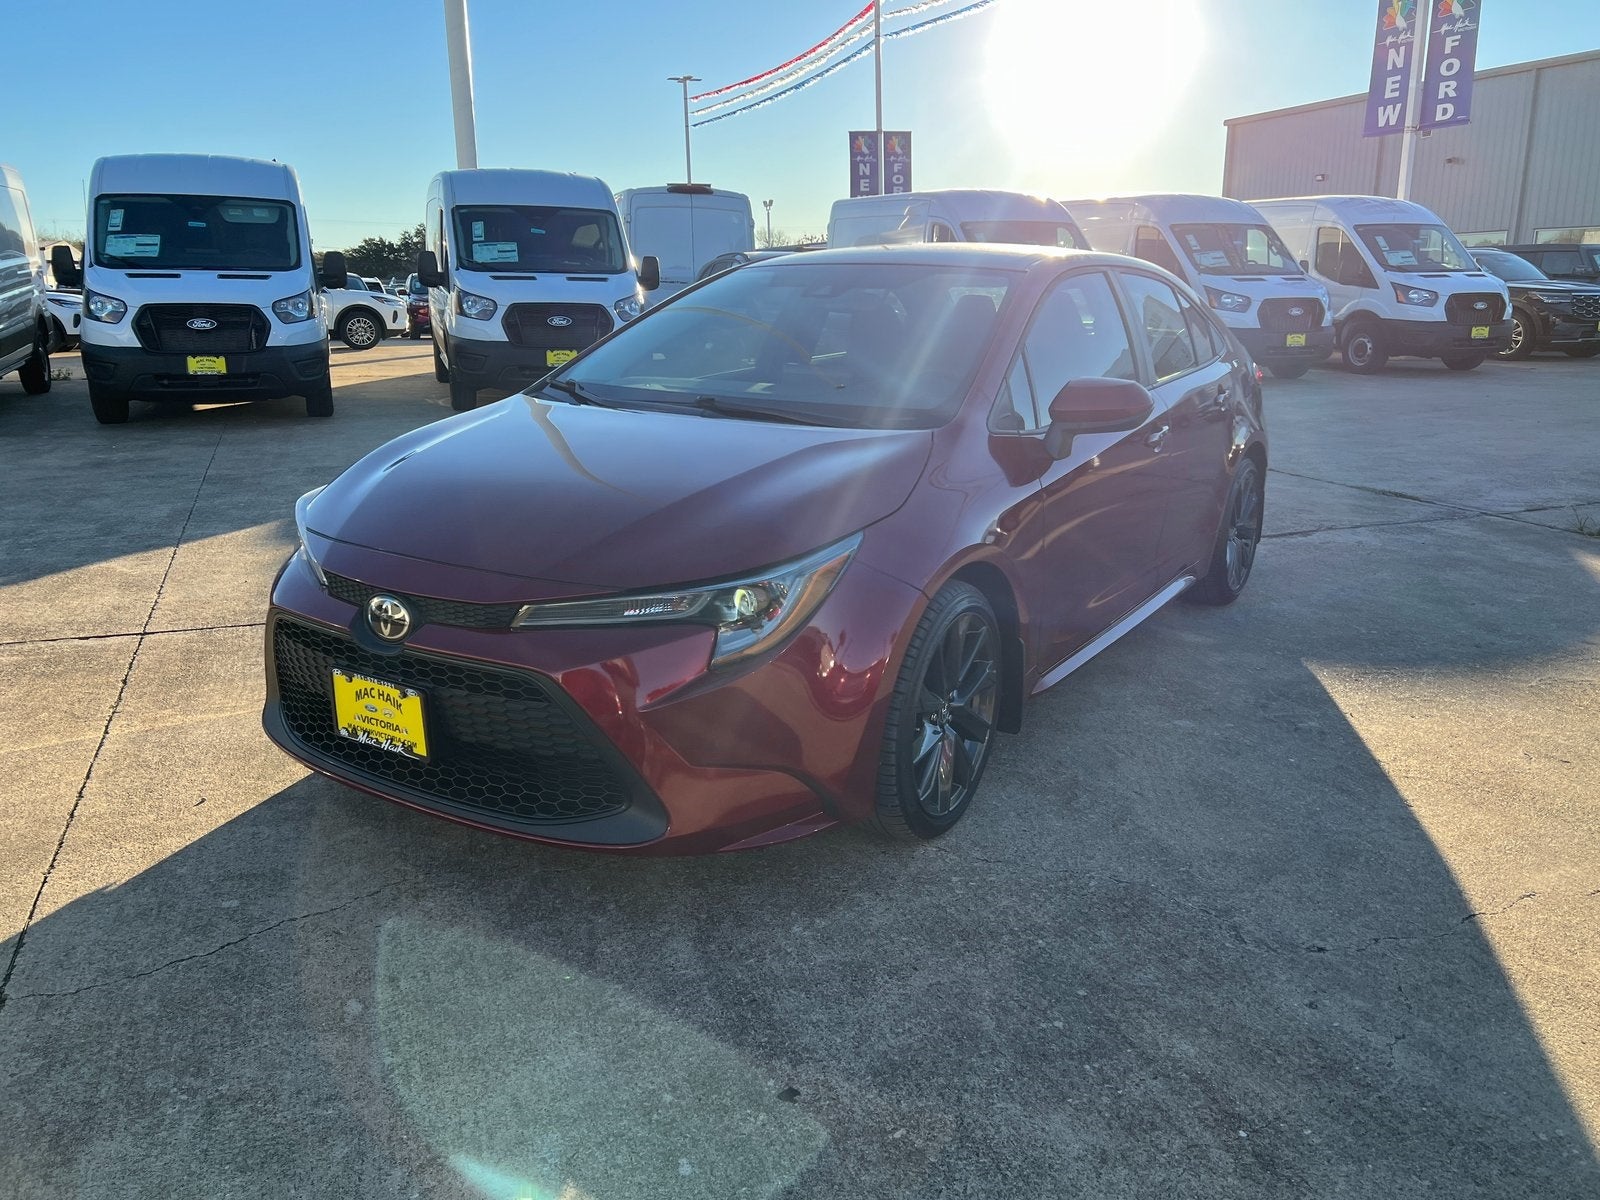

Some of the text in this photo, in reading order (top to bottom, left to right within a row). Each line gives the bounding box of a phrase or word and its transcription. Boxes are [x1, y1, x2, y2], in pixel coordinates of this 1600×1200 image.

[1378, 45, 1406, 128] NEW
[1435, 34, 1462, 122] FORD
[858, 162, 871, 192] NE
[892, 163, 904, 194] FOR
[355, 687, 404, 714] MAC HAIK
[360, 714, 401, 735] VICTORIA
[356, 732, 405, 754] Mac Haik
